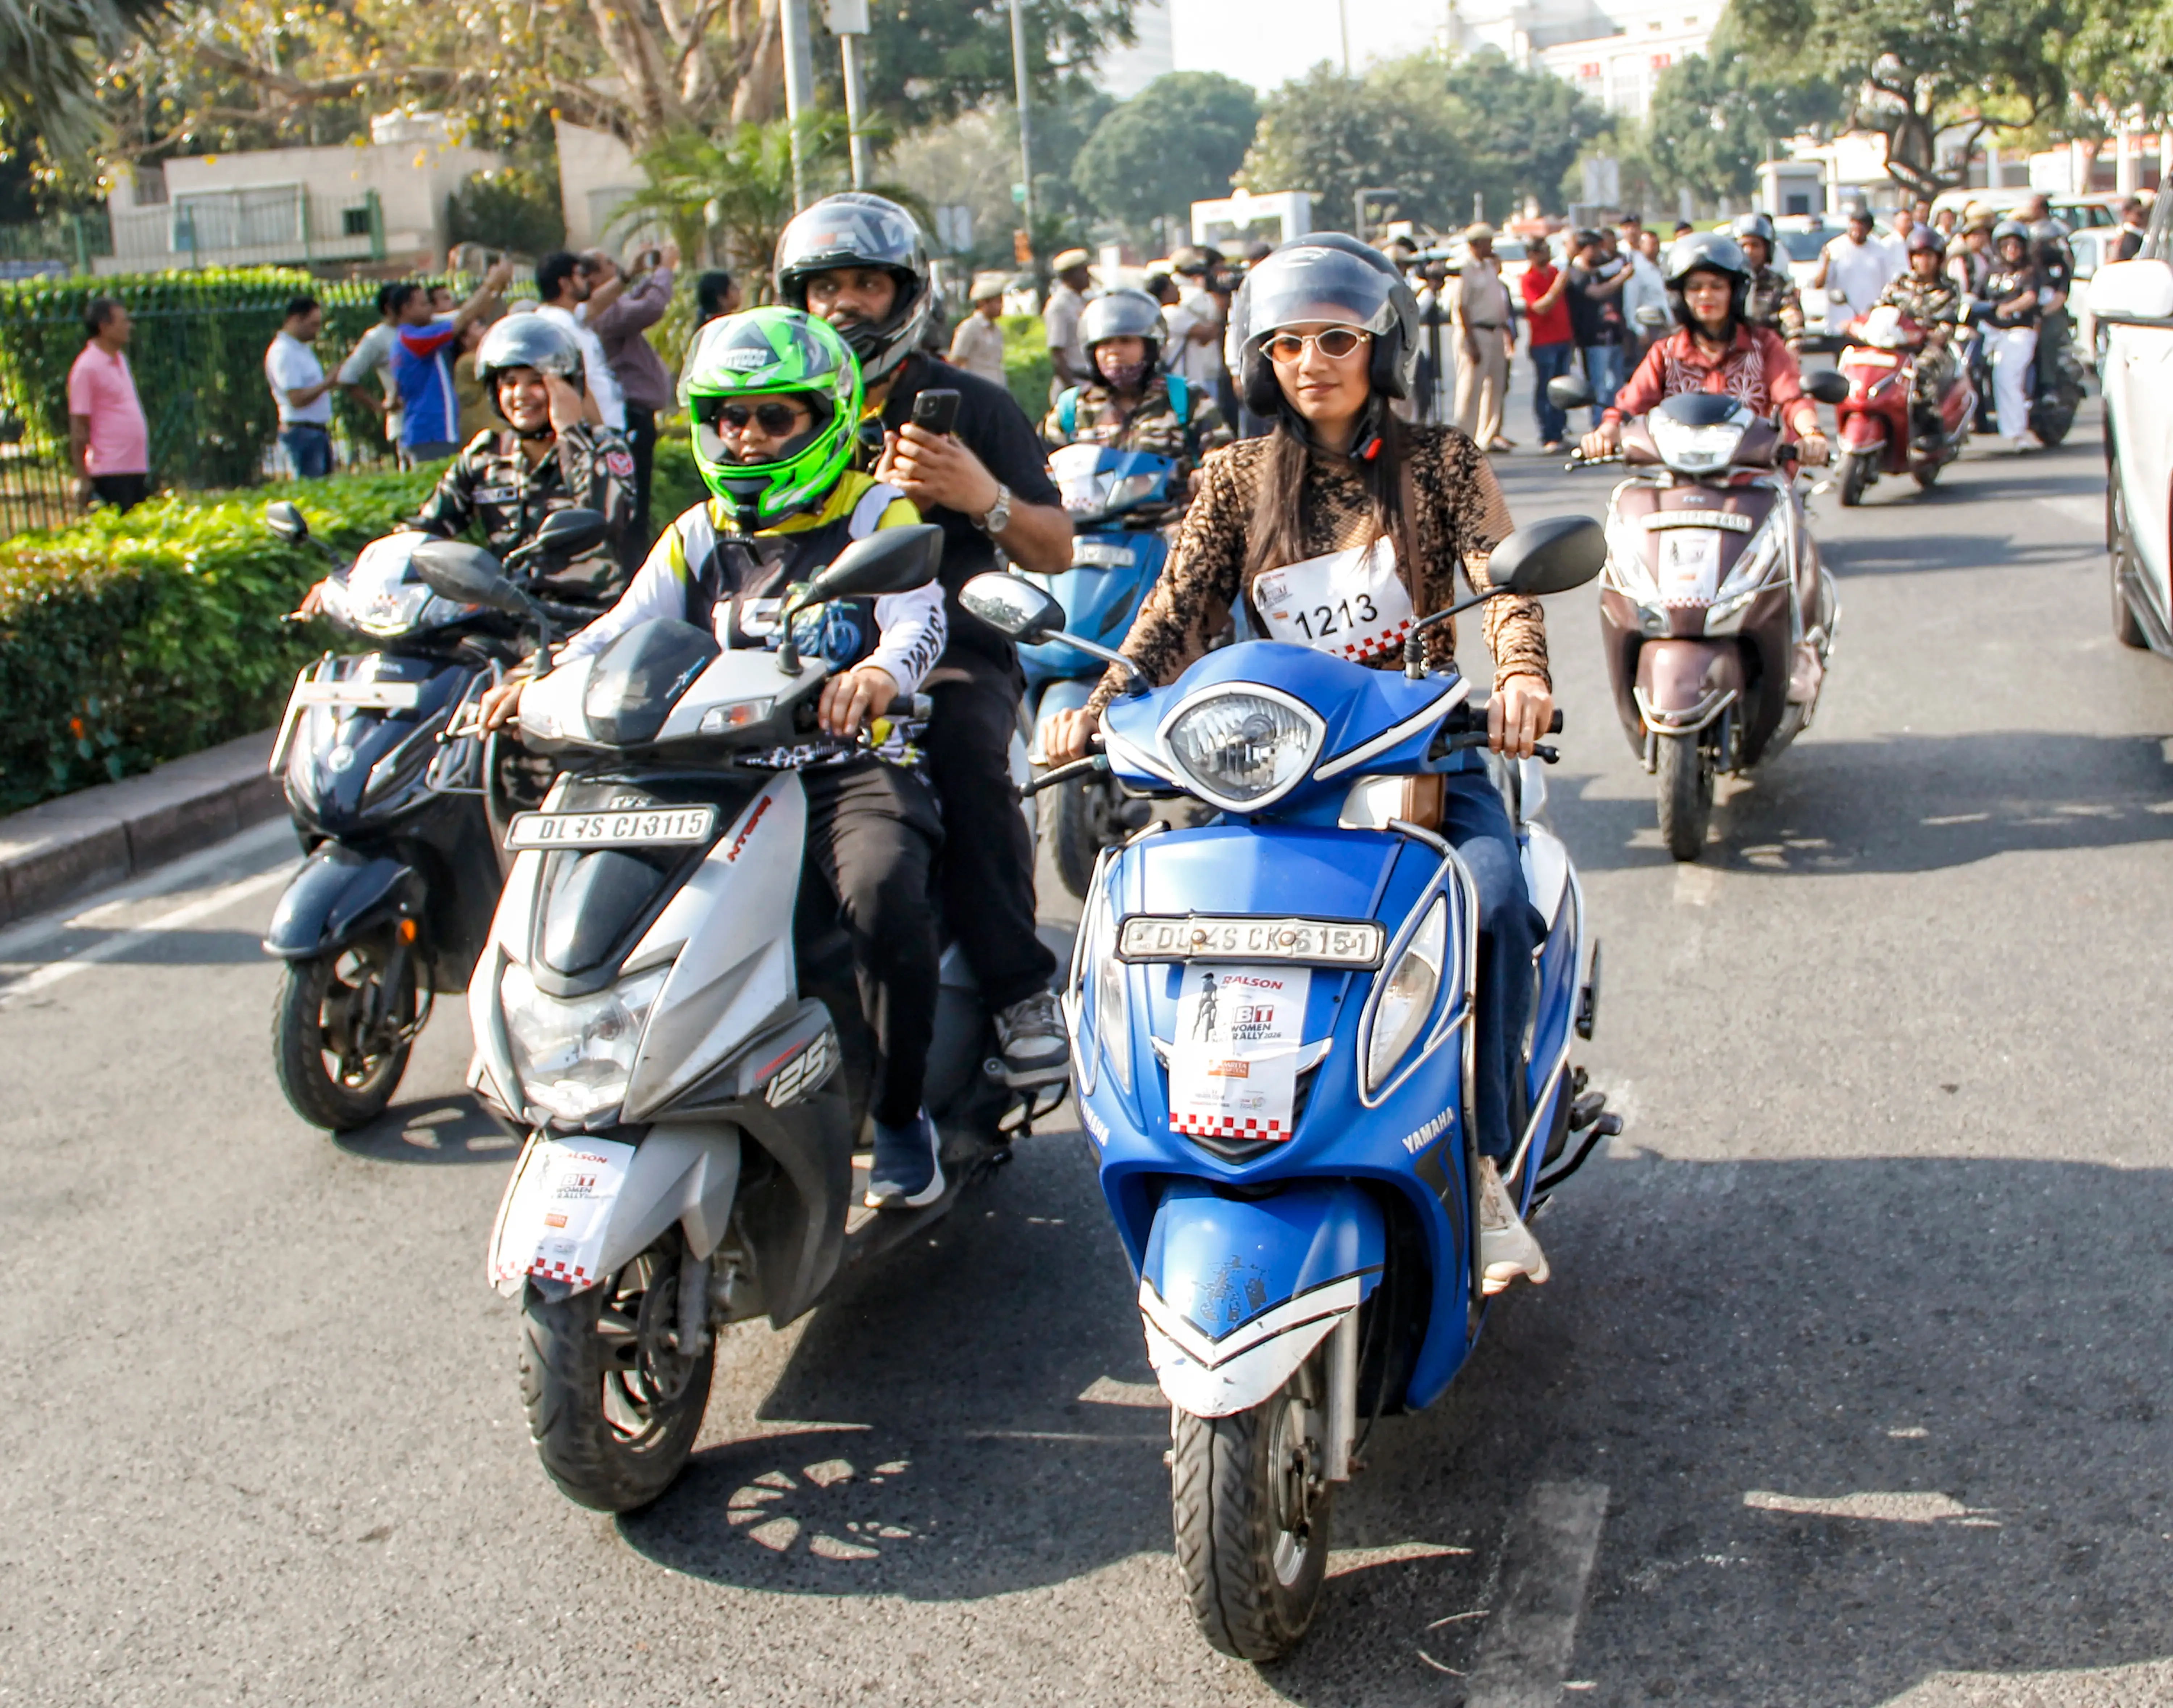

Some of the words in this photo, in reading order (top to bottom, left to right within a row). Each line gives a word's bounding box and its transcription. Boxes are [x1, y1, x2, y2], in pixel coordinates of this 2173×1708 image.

[1294, 593, 1378, 639] 1213
[539, 818, 566, 839] DL
[574, 817, 604, 838] 7S
[1157, 927, 1189, 949] DL
[1222, 975, 1284, 990] RALSON
[1231, 1023, 1271, 1032] WOMEN
[1233, 1032, 1264, 1040] RALLY
[765, 1032, 827, 1109] 125
[1401, 1106, 1456, 1154] YAMAHA
[567, 1153, 607, 1163] ALSON
